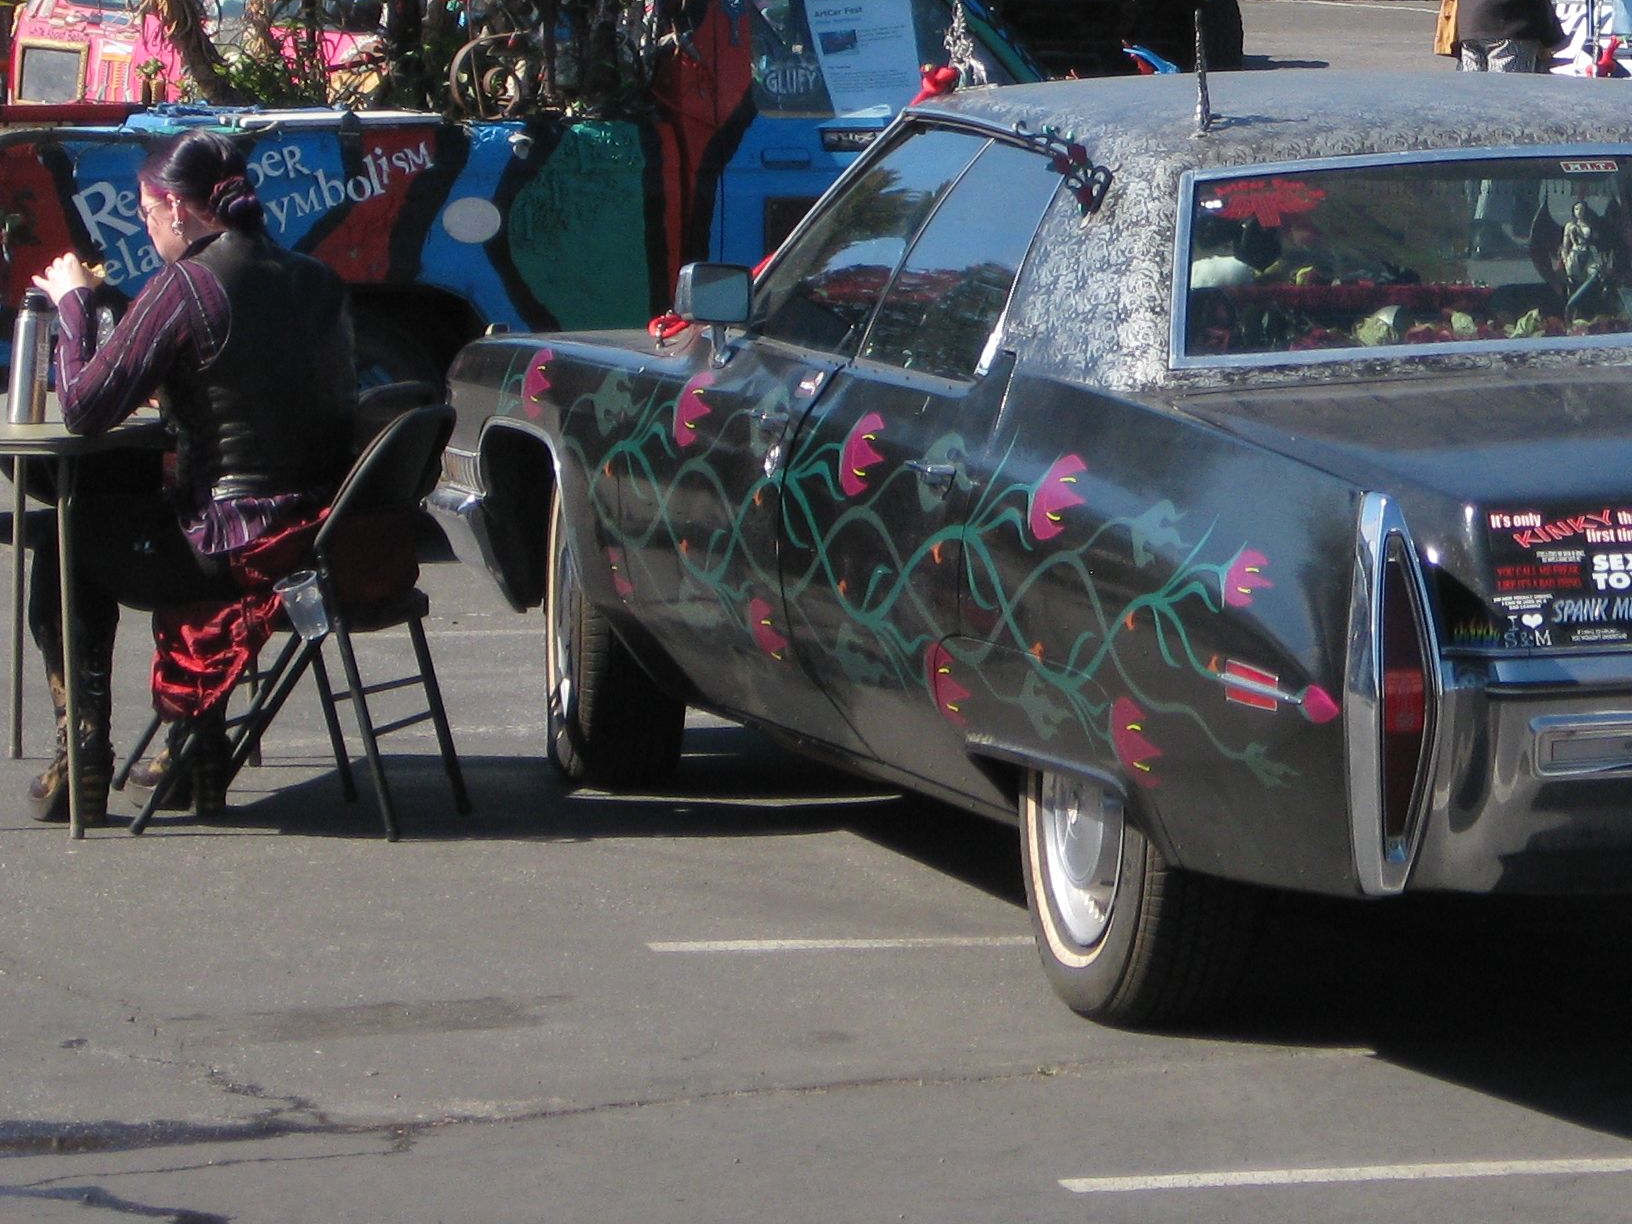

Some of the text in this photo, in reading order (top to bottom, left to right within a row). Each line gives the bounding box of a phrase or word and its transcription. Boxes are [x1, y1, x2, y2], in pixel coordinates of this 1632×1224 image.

[1490, 512, 1542, 528] It's only
[1512, 509, 1613, 549] KINKY
[1586, 528, 1615, 543] first
[1551, 597, 1609, 624] SPANK
[1507, 614, 1519, 632] I
